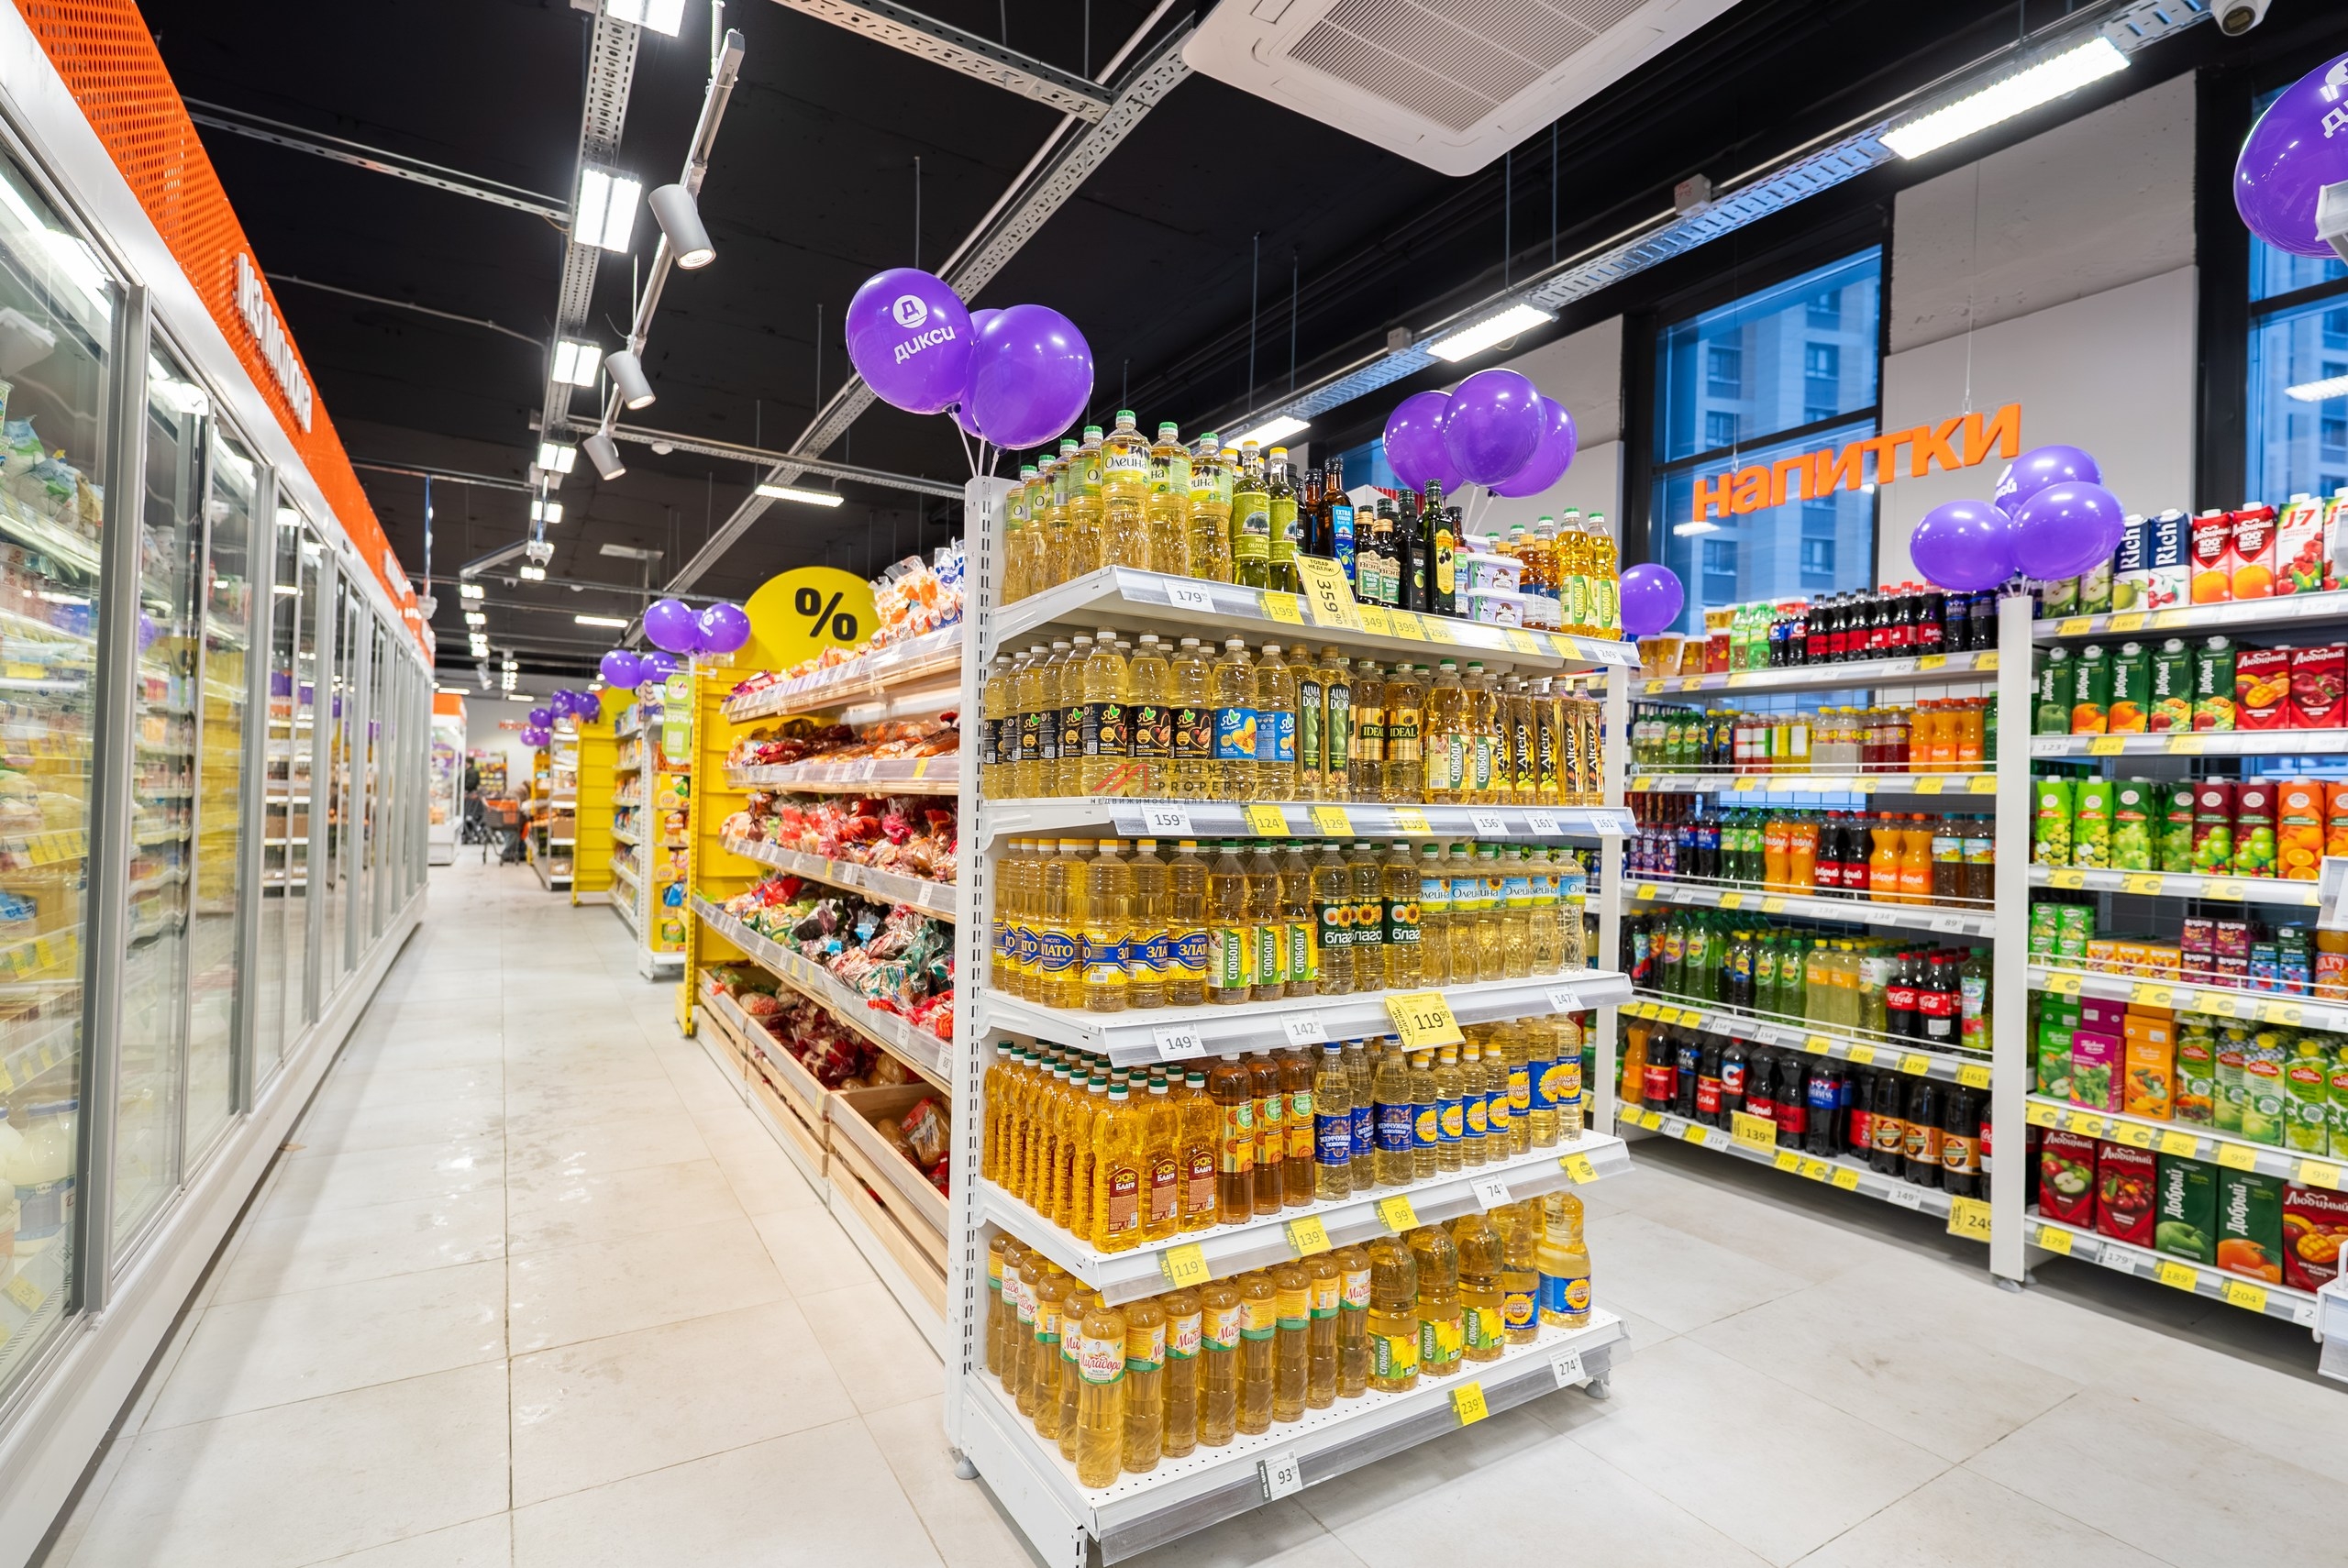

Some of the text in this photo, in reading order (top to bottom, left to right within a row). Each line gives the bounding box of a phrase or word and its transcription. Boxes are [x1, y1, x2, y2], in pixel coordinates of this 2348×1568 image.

[1692, 403, 2021, 523] напитки
[2120, 526, 2140, 569] Rich
[2156, 522, 2177, 566] Rich
[1177, 590, 1202, 603] 179
[1317, 580, 1338, 613] 359
[1272, 606, 1293, 617] 199
[1363, 616, 1382, 627] 349
[1397, 622, 1415, 633] 399
[1330, 688, 1350, 701] ALMA
[1390, 727, 1416, 738] IDEAL
[1517, 724, 1527, 768] Altero
[1540, 726, 1550, 769] Altero
[1567, 728, 1576, 768] Altero
[1588, 729, 1596, 769] Altero
[1451, 742, 1460, 782] СЛОБОДА
[1478, 743, 1486, 783] СЛОБОДА
[1155, 813, 1180, 826] 159
[1257, 818, 1280, 829] 124
[1324, 819, 1344, 829] 129
[1479, 818, 1499, 828] 156
[1534, 818, 1552, 828] 161
[1597, 818, 1614, 828] 161
[1227, 936, 1238, 980] СЛОБОДА
[1264, 934, 1273, 977] СЛОБОДА
[1295, 932, 1304, 974] СЛОБОДА
[1555, 993, 1572, 1004] 147
[1413, 1012, 1444, 1030] 119
[1292, 1022, 1317, 1036] 142
[1166, 1035, 1191, 1050] 149
[1746, 1129, 1767, 1143] 139
[2101, 1146, 2153, 1165] Любимый
[1487, 1184, 1501, 1197] 74
[2165, 1168, 2184, 1220] Добрый
[1394, 1210, 1409, 1222] 99
[2227, 1182, 2247, 1236] Добрый
[1301, 1232, 1321, 1246] 139
[2108, 1253, 2129, 1264] 179
[1175, 1261, 1200, 1277] 119
[2165, 1270, 2188, 1284] 189
[2232, 1291, 2258, 1304] 204
[1424, 1326, 1433, 1360] СЛОБОДА
[1379, 1341, 1388, 1375] СЛОБОДА
[1557, 1360, 1577, 1375] 274
[1461, 1397, 1479, 1415] 239
[1278, 1469, 1293, 1485] 93
